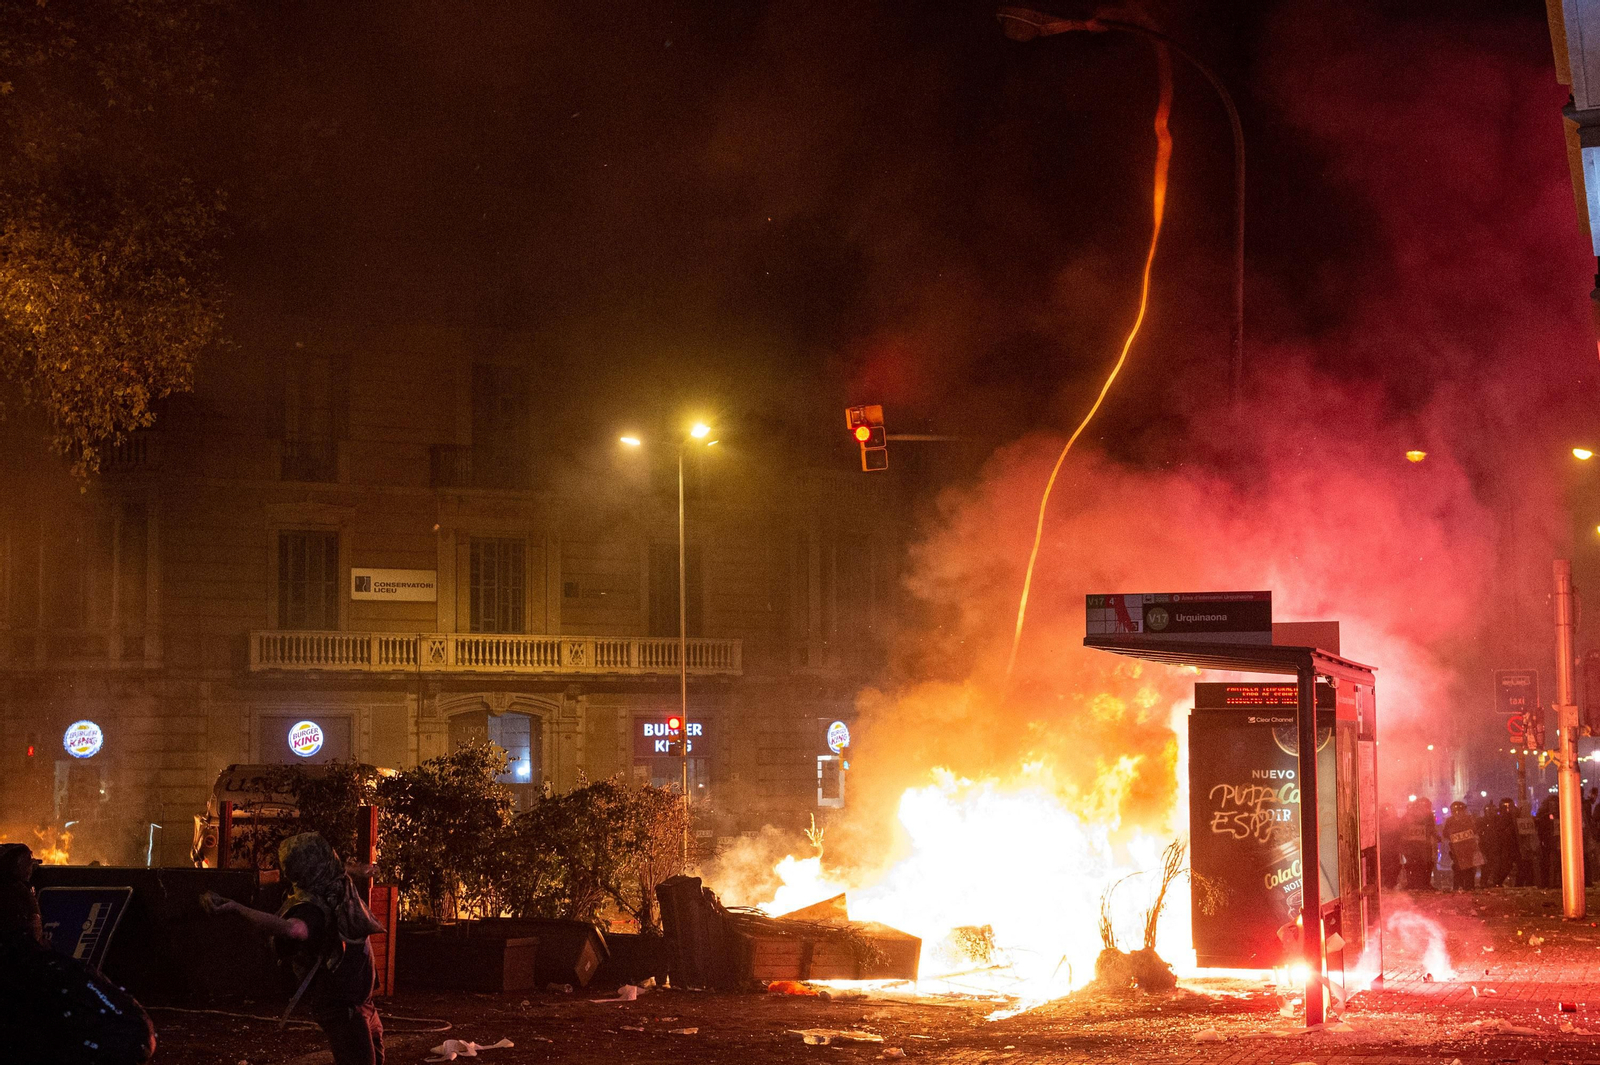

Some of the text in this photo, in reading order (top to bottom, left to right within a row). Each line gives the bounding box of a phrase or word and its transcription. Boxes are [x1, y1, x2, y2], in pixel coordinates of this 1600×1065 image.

[374, 581, 434, 589] CONSERVATORI
[1088, 597, 1104, 606] V17
[1148, 613, 1228, 623] V17 Urquinaona
[1509, 696, 1525, 705] taxi
[293, 728, 319, 740] BURGER
[294, 734, 320, 748] KING
[1252, 769, 1295, 779] NUEVO
[1209, 784, 1282, 812] PUTA
[1264, 859, 1302, 890] ColaC
